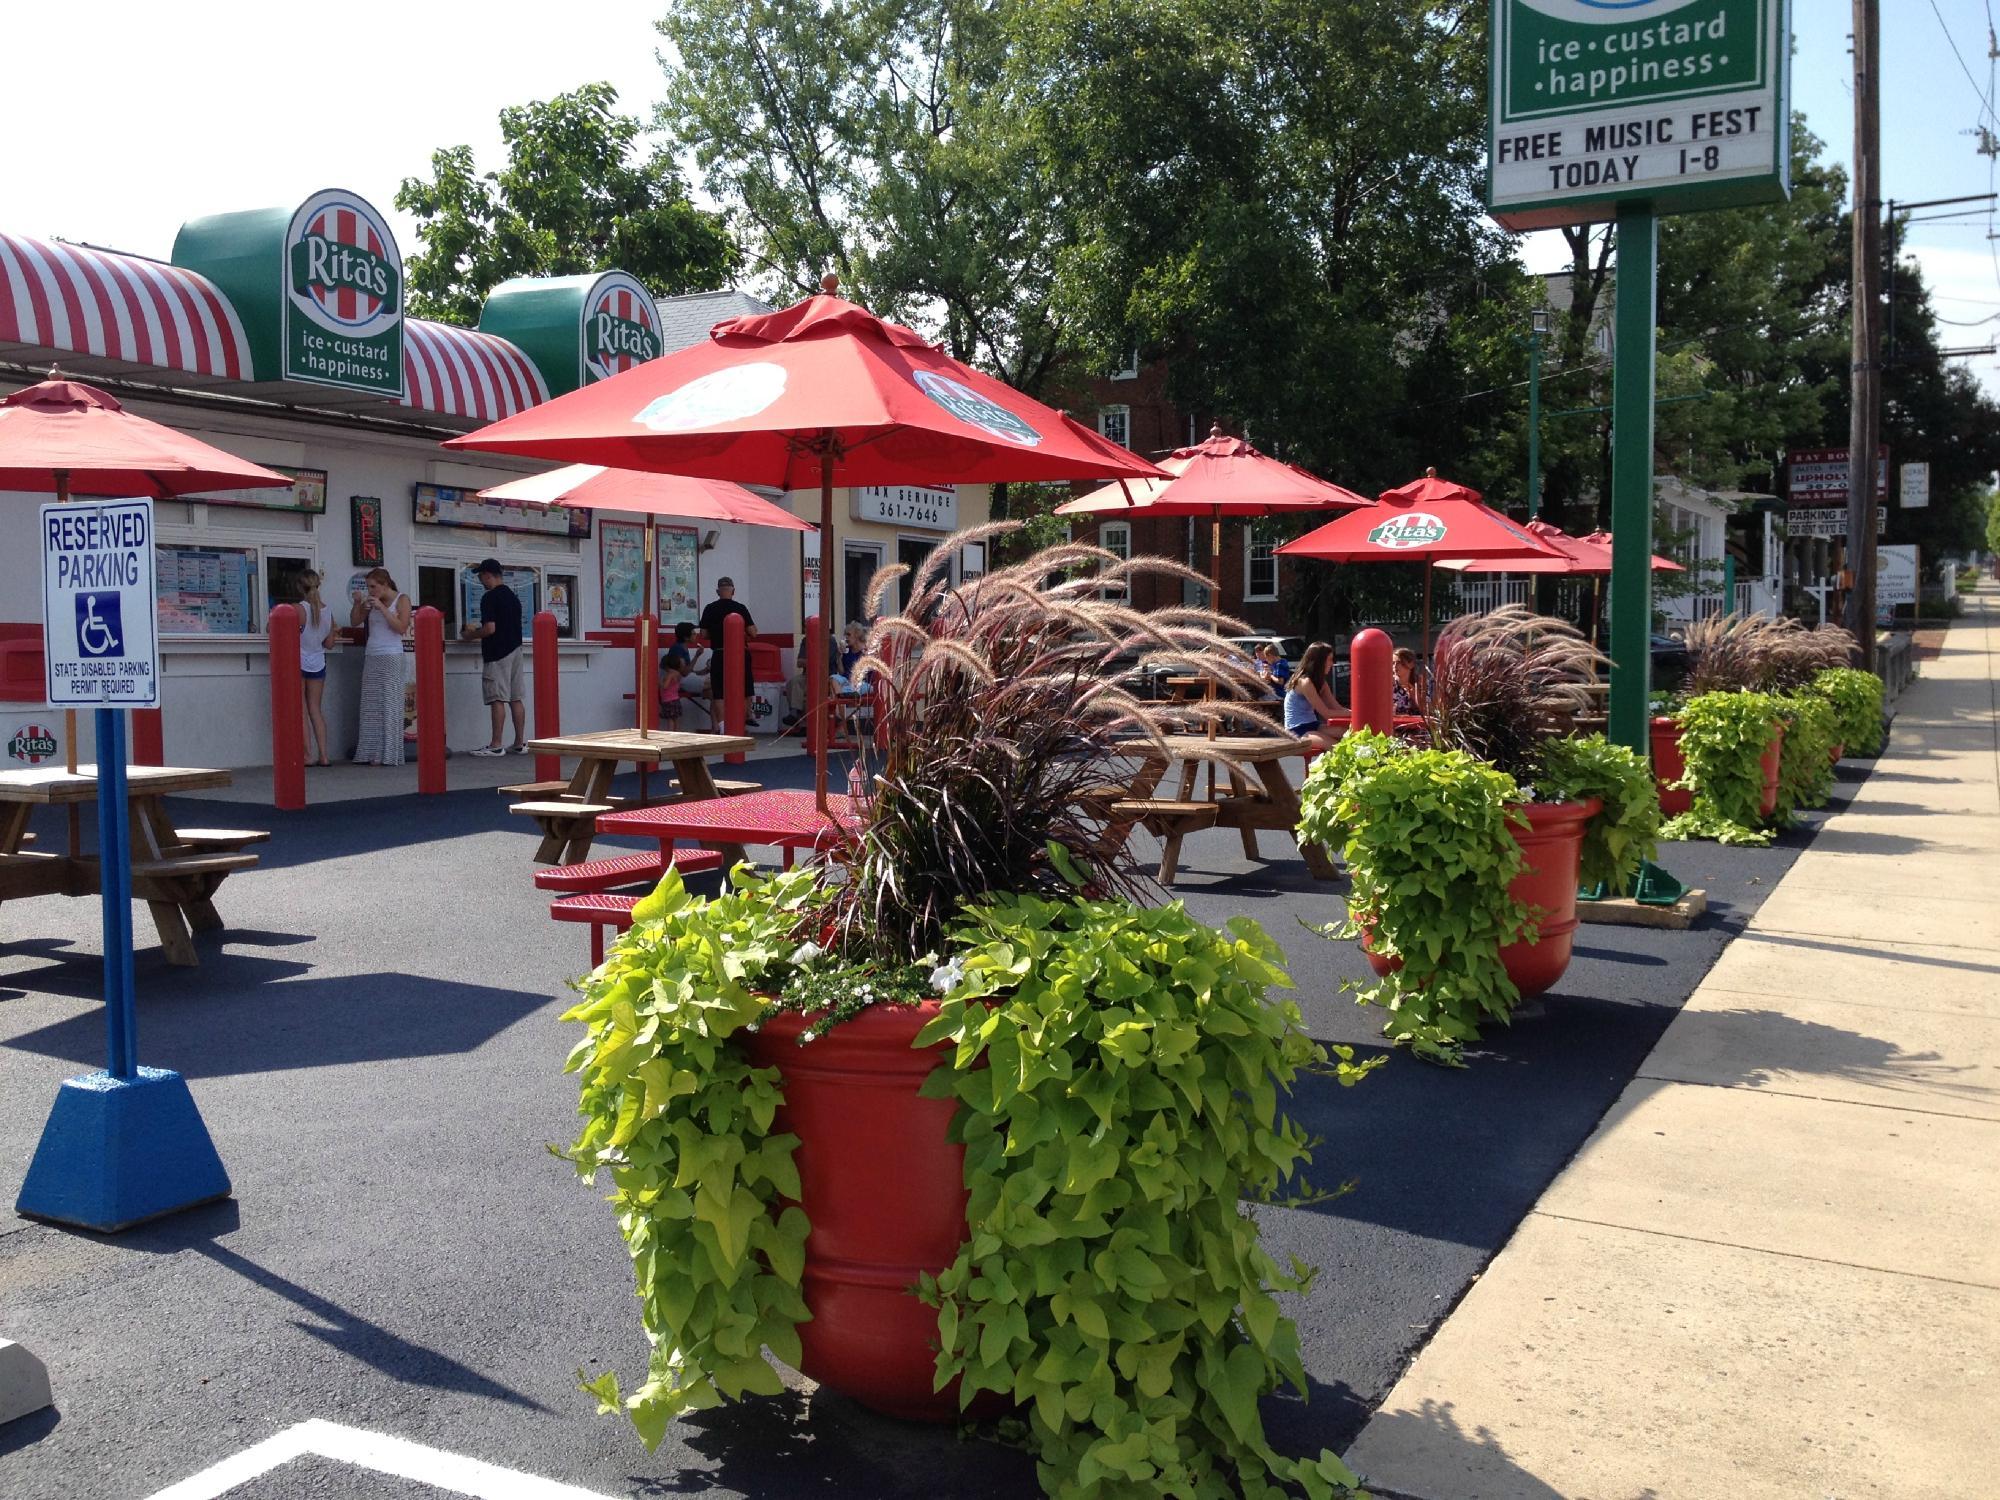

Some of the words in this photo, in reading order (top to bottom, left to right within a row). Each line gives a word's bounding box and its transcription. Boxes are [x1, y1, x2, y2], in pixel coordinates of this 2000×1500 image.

[1538, 38, 1581, 64] ice
[1604, 10, 1726, 54] custard
[1550, 52, 1713, 97] happiness
[1498, 131, 1563, 164] FREE
[1585, 117, 1673, 153] MUSIC
[1691, 106, 1761, 140] FEST
[1548, 155, 1639, 190] TODAY
[308, 236, 388, 296] Rita's
[303, 330, 324, 350] ice
[334, 340, 388, 362] custard
[598, 312, 653, 361] Rita's
[309, 352, 383, 381] happiness
[880, 502, 938, 523] 361-7646
[899, 489, 951, 508] SERVICE
[49, 512, 145, 552] RESERVED
[360, 503, 377, 561] OPEN
[1789, 510, 1836, 521] PARKING
[1380, 525, 1438, 540] Rita's
[58, 551, 138, 589] PARKING
[55, 663, 78, 677] STATE
[81, 663, 116, 676] DISABLED
[119, 662, 150, 676] PARKING
[71, 680, 98, 694] PERMIT
[102, 680, 135, 693] REQUIRED
[15, 737, 54, 753] Rita's
